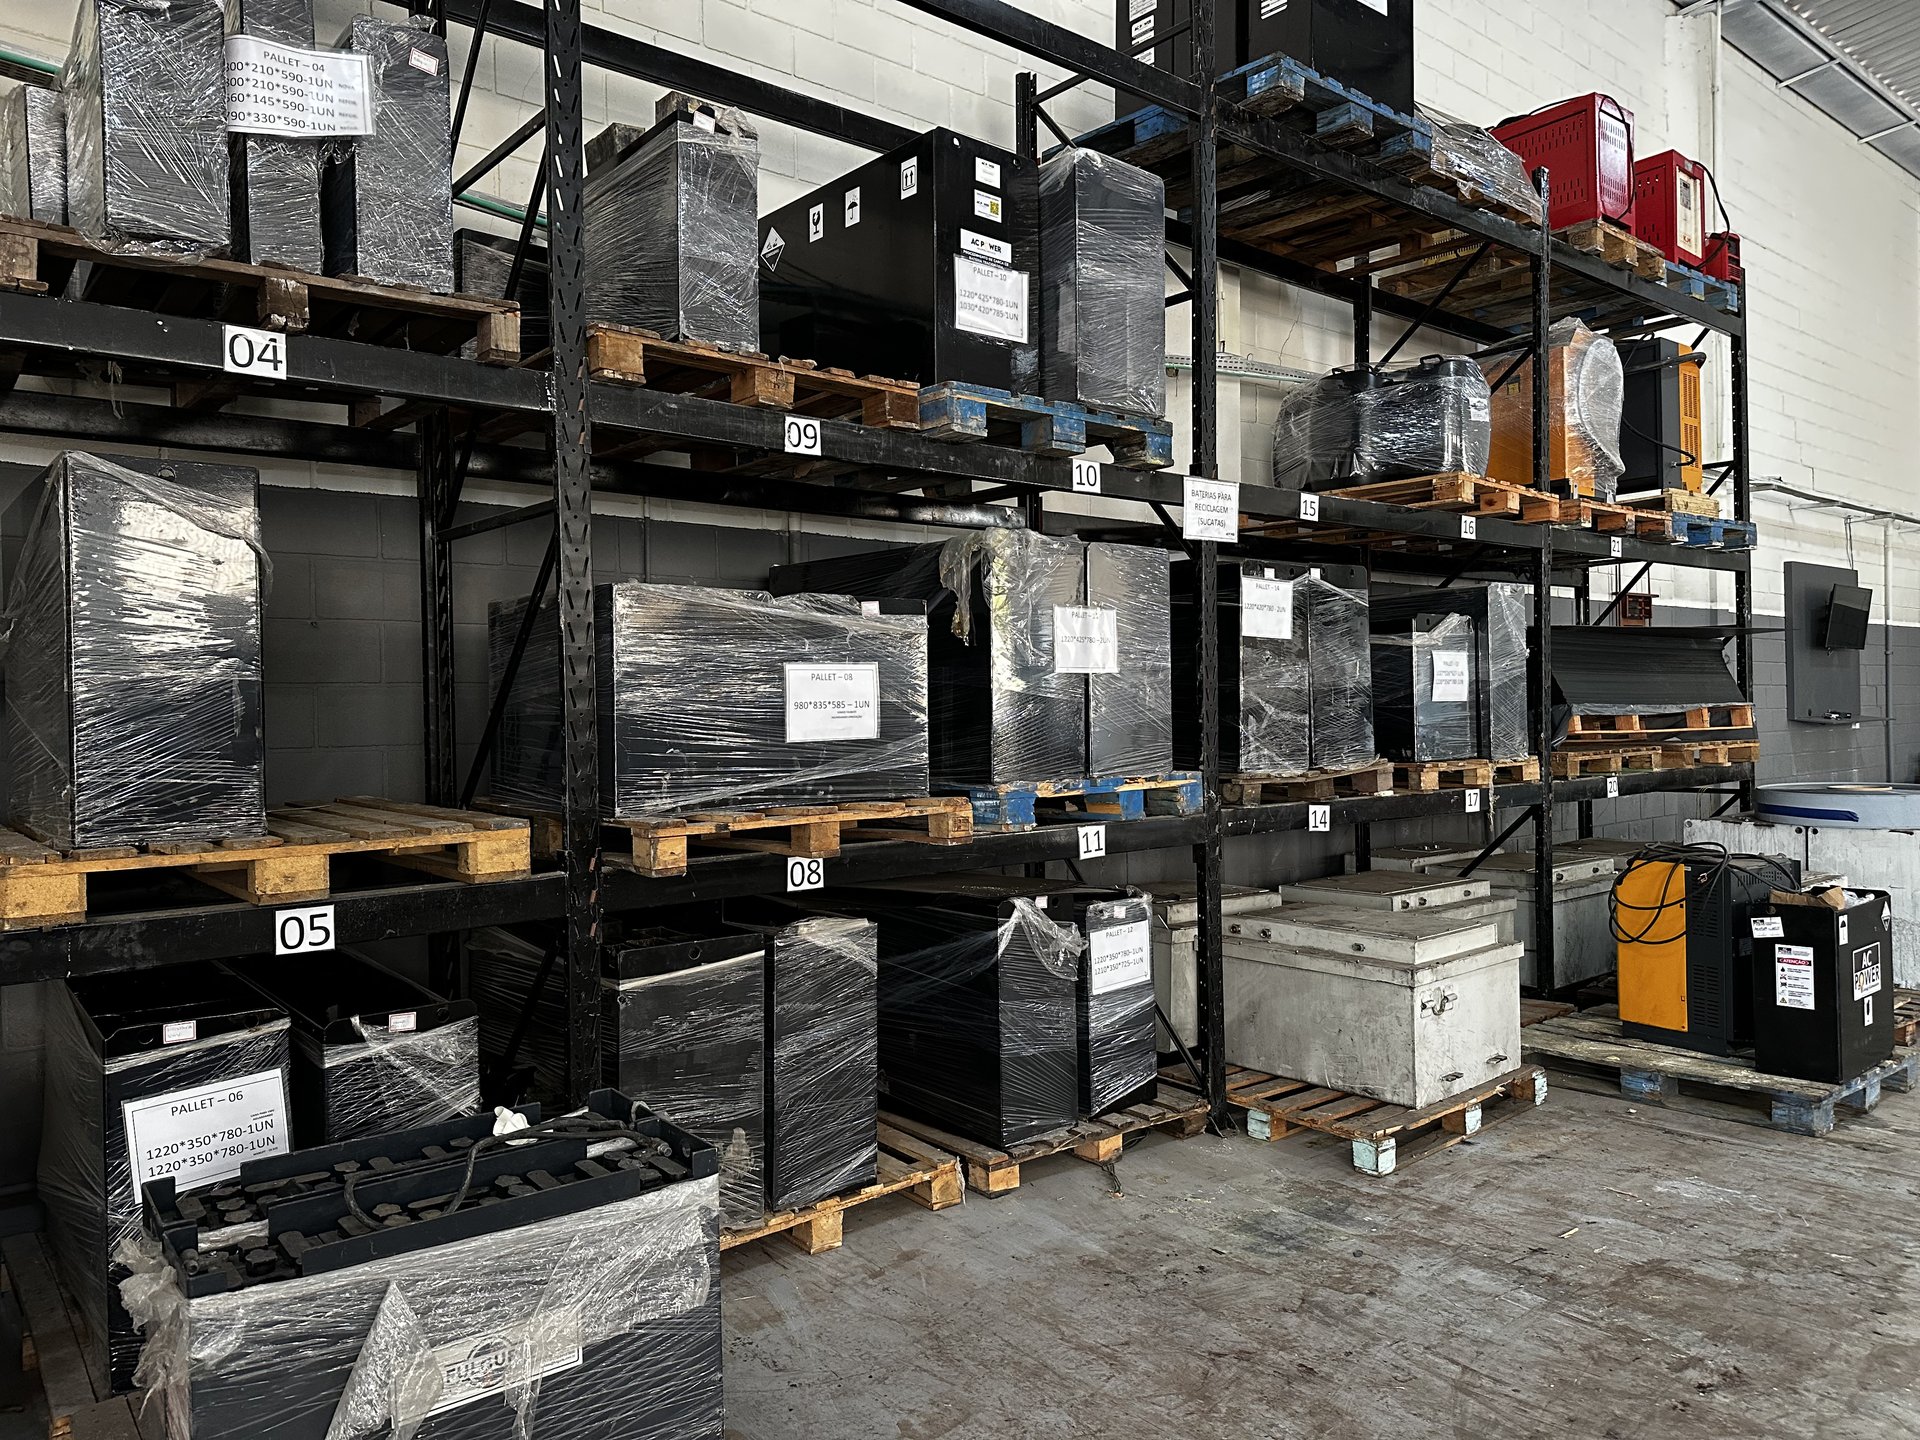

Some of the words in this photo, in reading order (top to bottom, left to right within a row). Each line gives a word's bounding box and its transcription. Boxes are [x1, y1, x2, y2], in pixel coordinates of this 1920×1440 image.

[263, 51, 300, 68] PALLET
[312, 63, 325, 72] 04
[971, 238, 979, 246] AC
[980, 240, 1001, 253] PWER
[973, 266, 994, 278] PALLET
[1000, 274, 1007, 282] 10
[229, 333, 283, 371] 04
[787, 421, 818, 449] 09
[1076, 464, 1097, 487] 10
[1191, 489, 1217, 500] BATERIAS
[1217, 492, 1232, 501] PARA
[1194, 503, 1229, 514] RECICLAGEM
[1302, 500, 1316, 517] 15
[1197, 517, 1226, 528] (SUCATAS)
[1463, 519, 1474, 535] 16
[1612, 539, 1620, 553] 21
[811, 673, 836, 681] PALLET
[844, 673, 853, 681] 08
[854, 700, 870, 709] 1UN
[1608, 780, 1618, 794] 20
[1467, 792, 1479, 807] 17
[1311, 810, 1328, 829] 14
[1083, 830, 1103, 854] 11
[790, 859, 821, 887] 08
[280, 913, 330, 950] 05
[1105, 928, 1122, 939] PALLET
[1127, 926, 1133, 934] 12
[1861, 949, 1873, 969] AC
[1855, 965, 1880, 991] POWER
[171, 1097, 215, 1117] PALLET
[228, 1090, 244, 1103] 06
